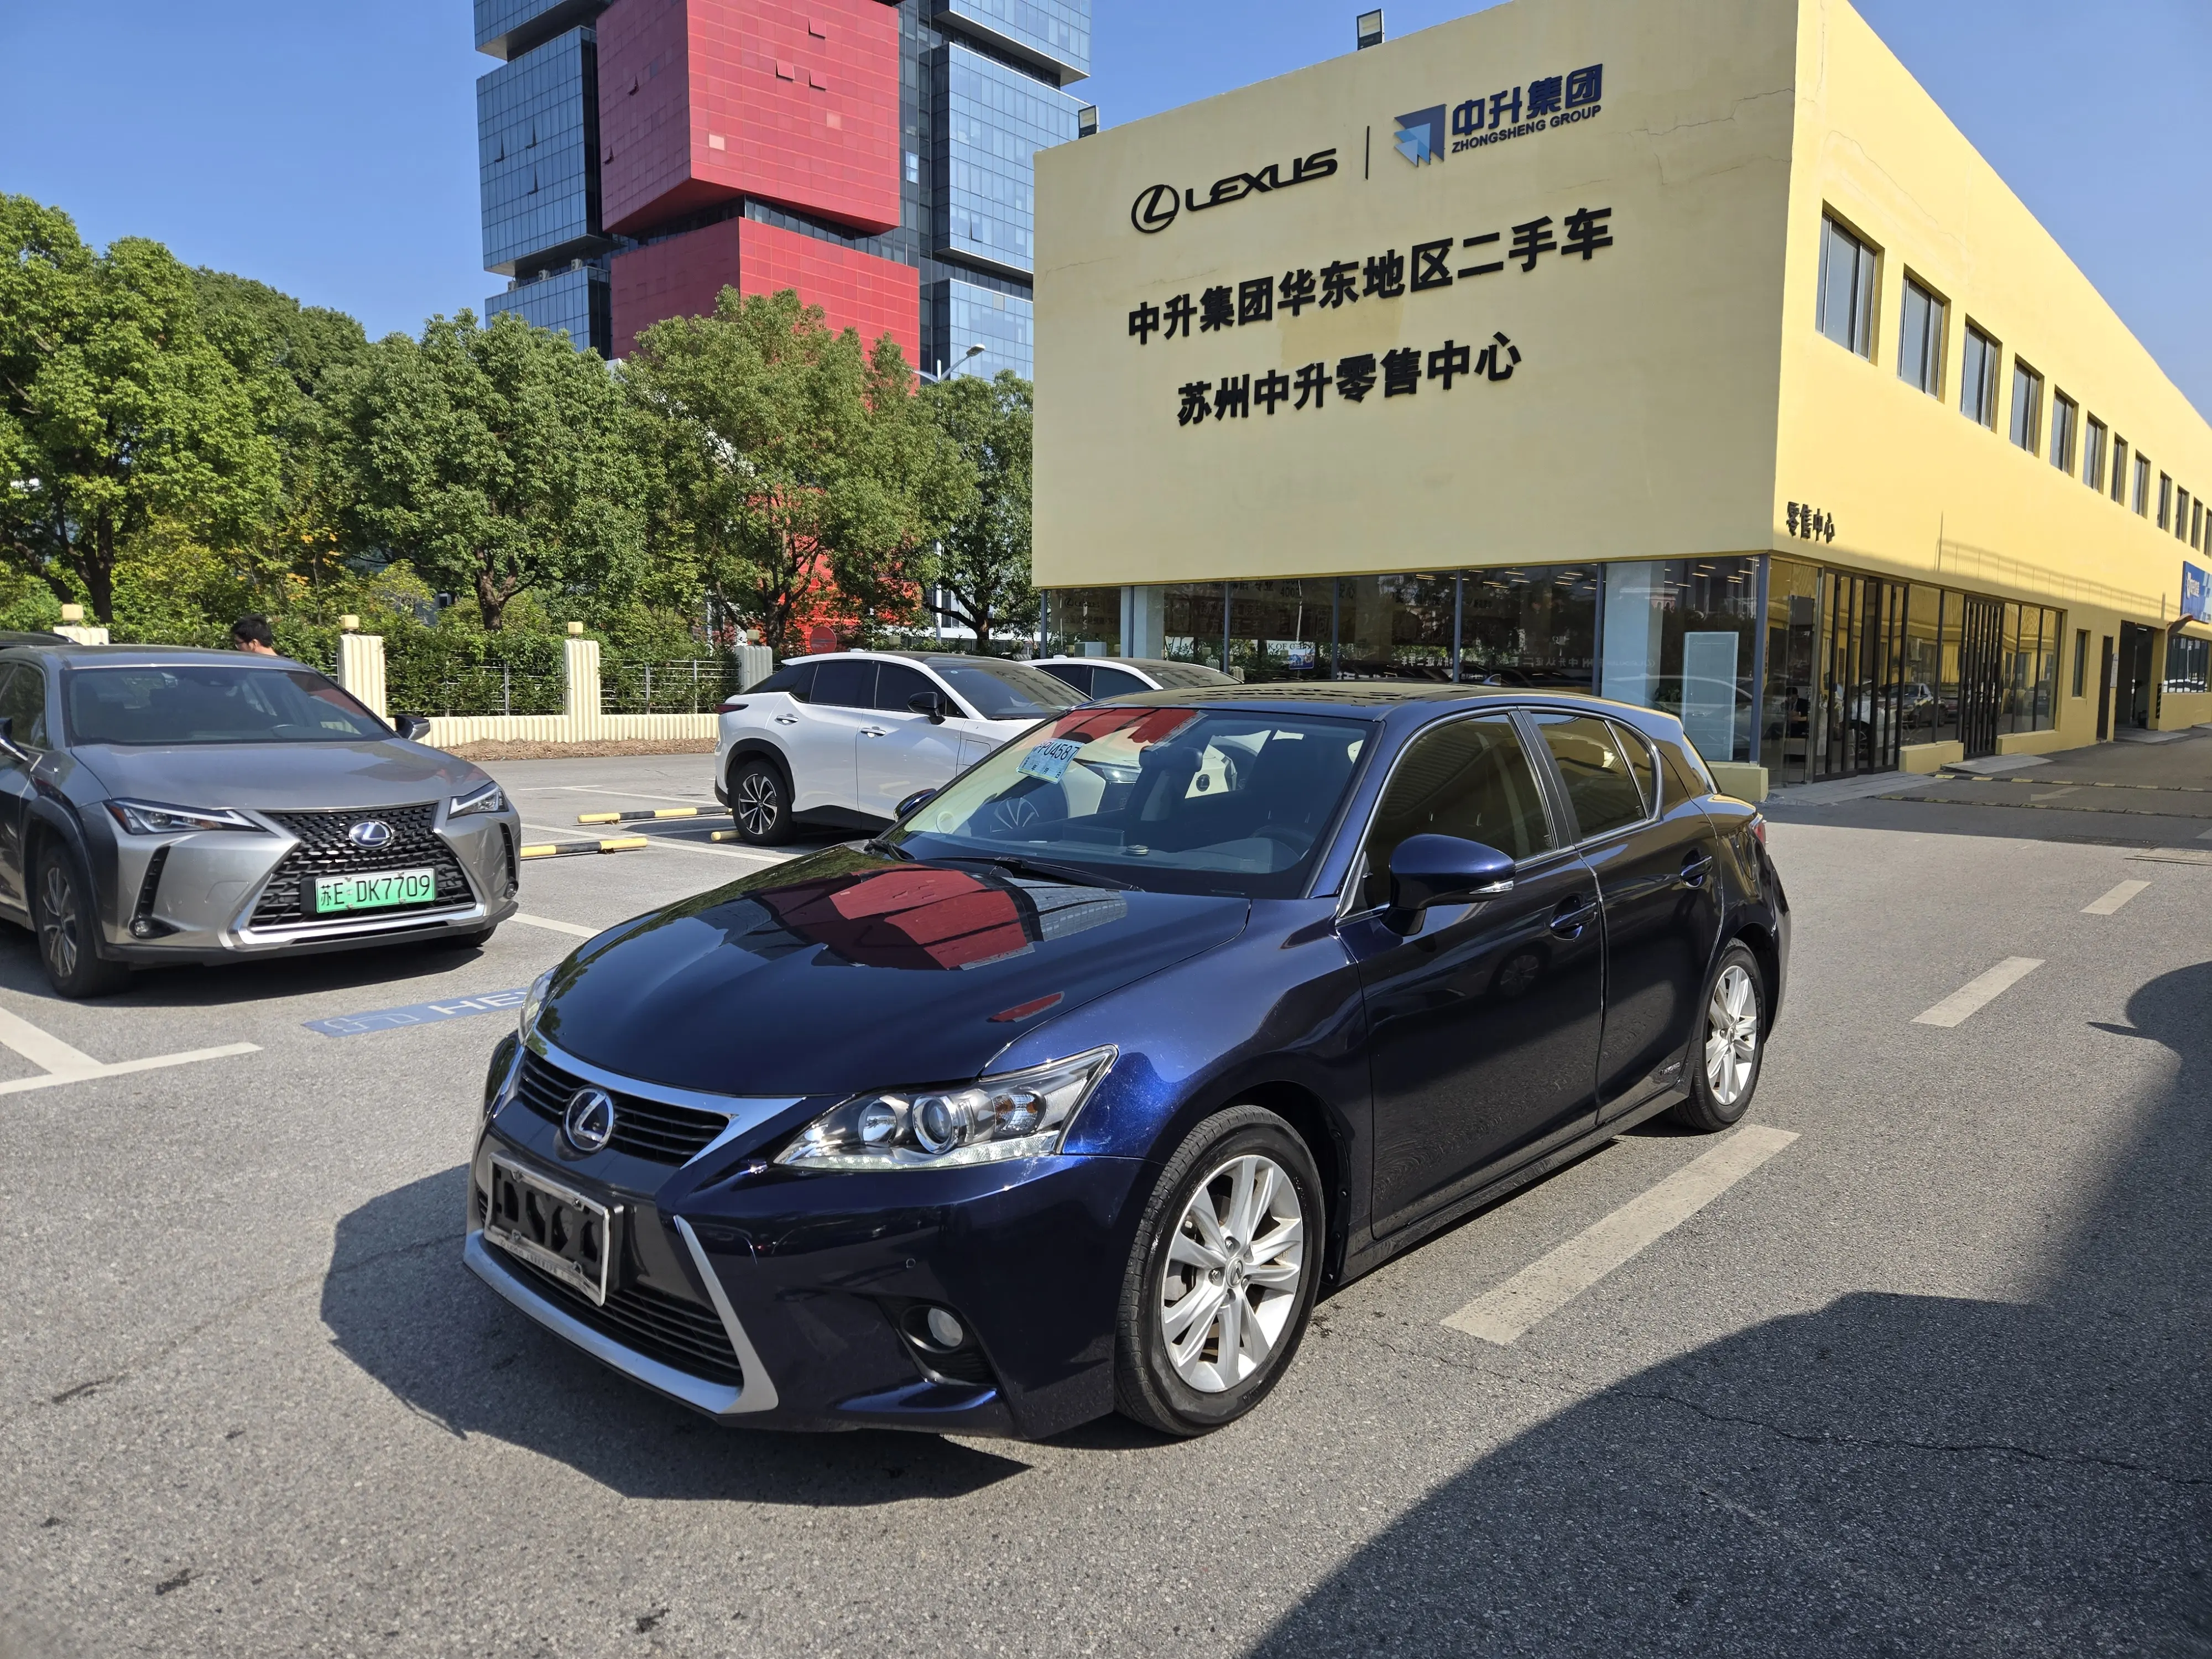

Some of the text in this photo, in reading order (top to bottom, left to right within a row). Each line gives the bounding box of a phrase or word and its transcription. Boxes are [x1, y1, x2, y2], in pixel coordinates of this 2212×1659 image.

[1452, 105, 1602, 154] ZHONGSHENG GROUP
[1453, 63, 1603, 136] 中升集团
[1185, 148, 1338, 212] LEXUS
[1128, 207, 1614, 345] 中升集团华东地区二手车
[1177, 331, 1522, 427] 苏州中升零售中心
[1786, 501, 1835, 545] 零售中心
[427, 991, 527, 1015] HE
